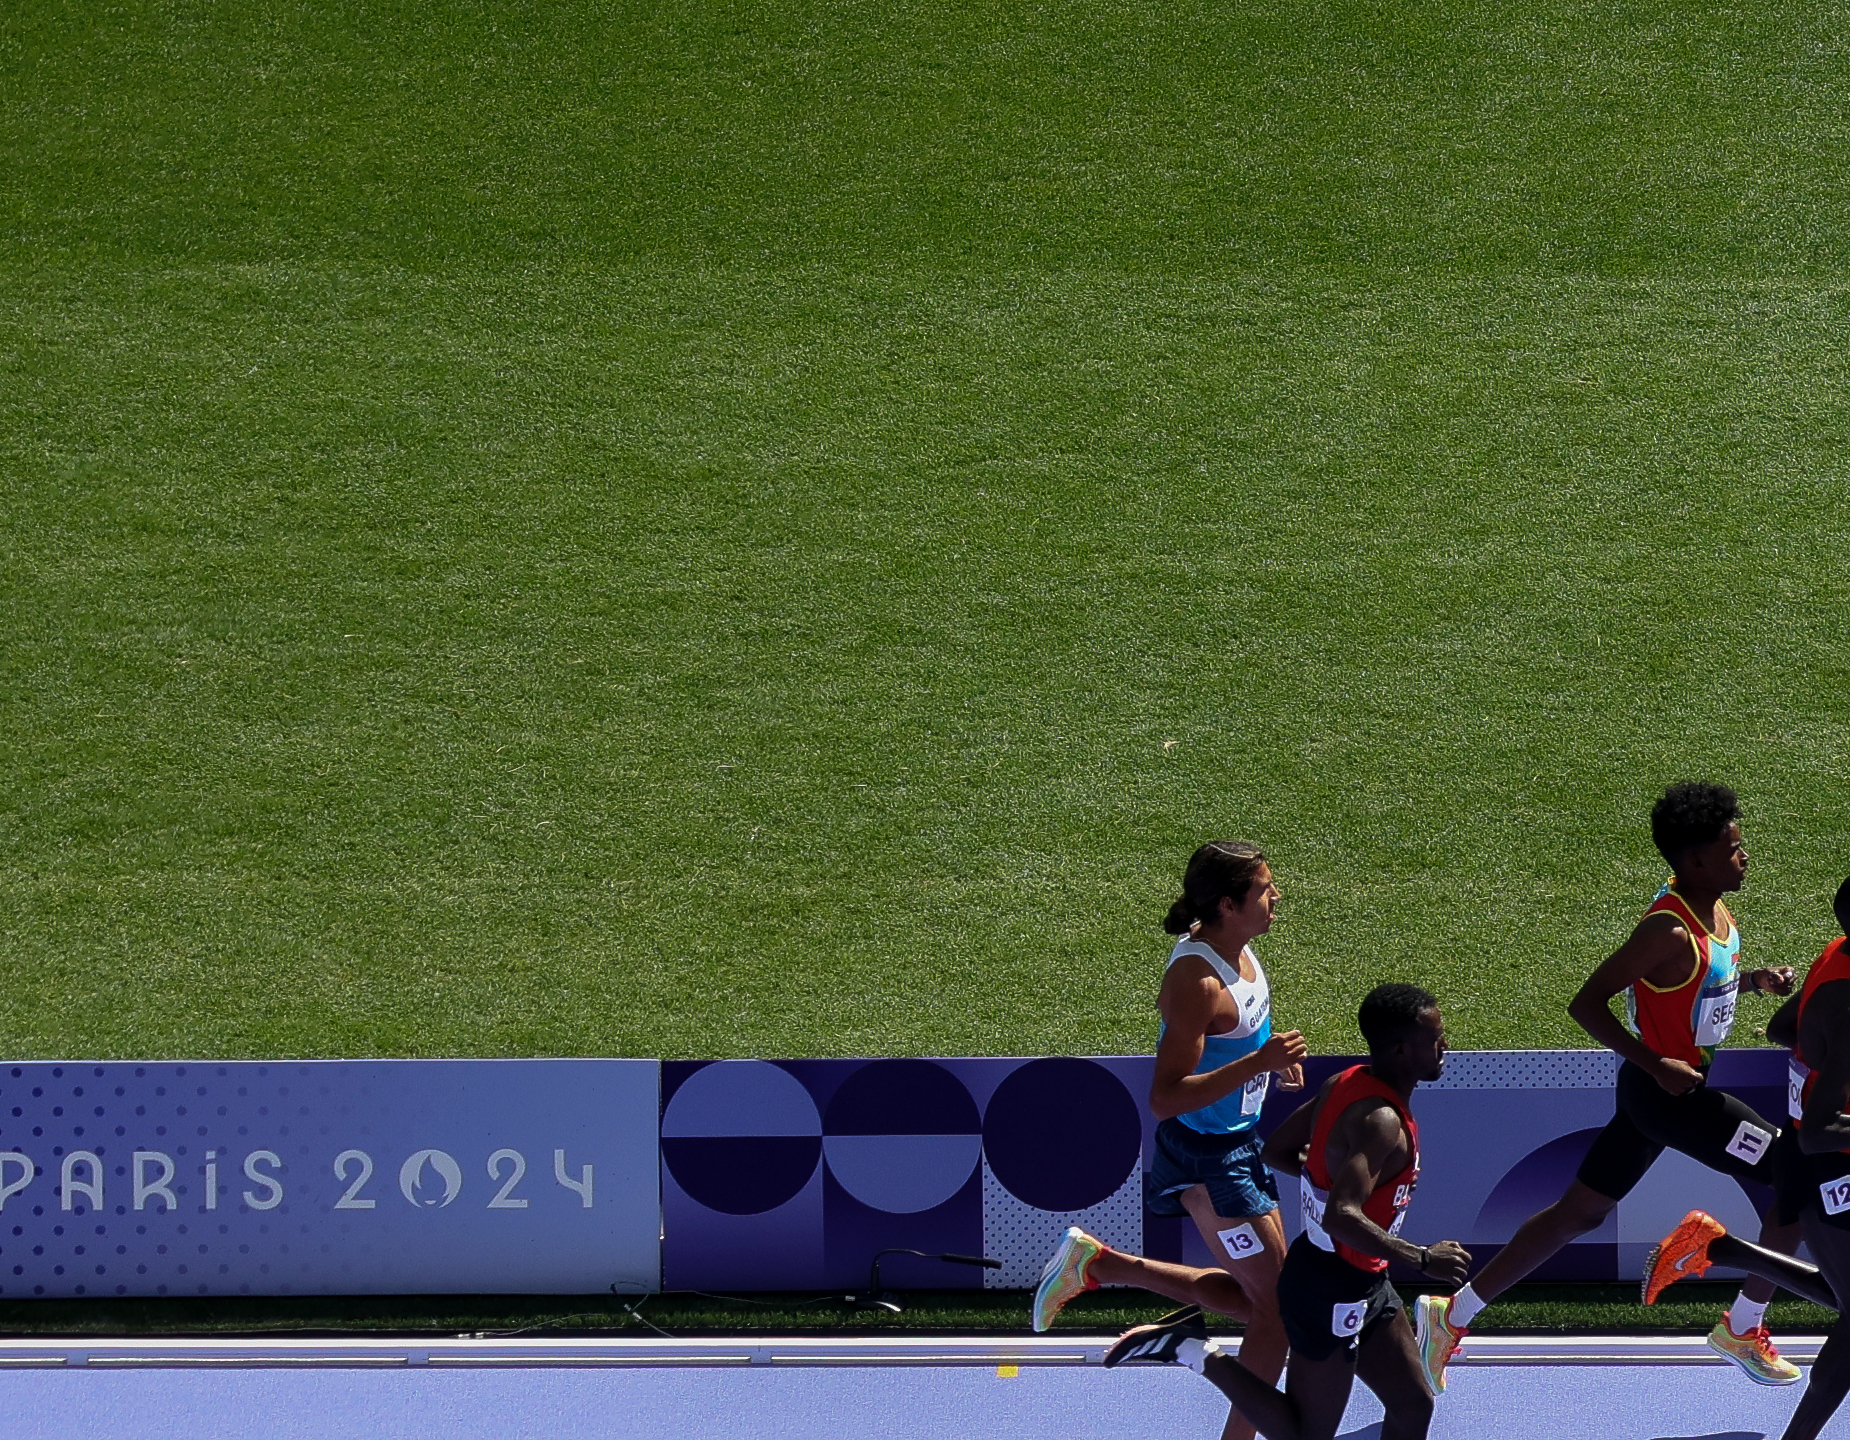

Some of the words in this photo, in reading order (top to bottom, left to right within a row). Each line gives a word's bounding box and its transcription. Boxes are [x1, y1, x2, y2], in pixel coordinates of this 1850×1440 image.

[1737, 1131, 1763, 1155] 11
[1226, 1233, 1254, 1252] 13
[1343, 1309, 1359, 1330] 6
